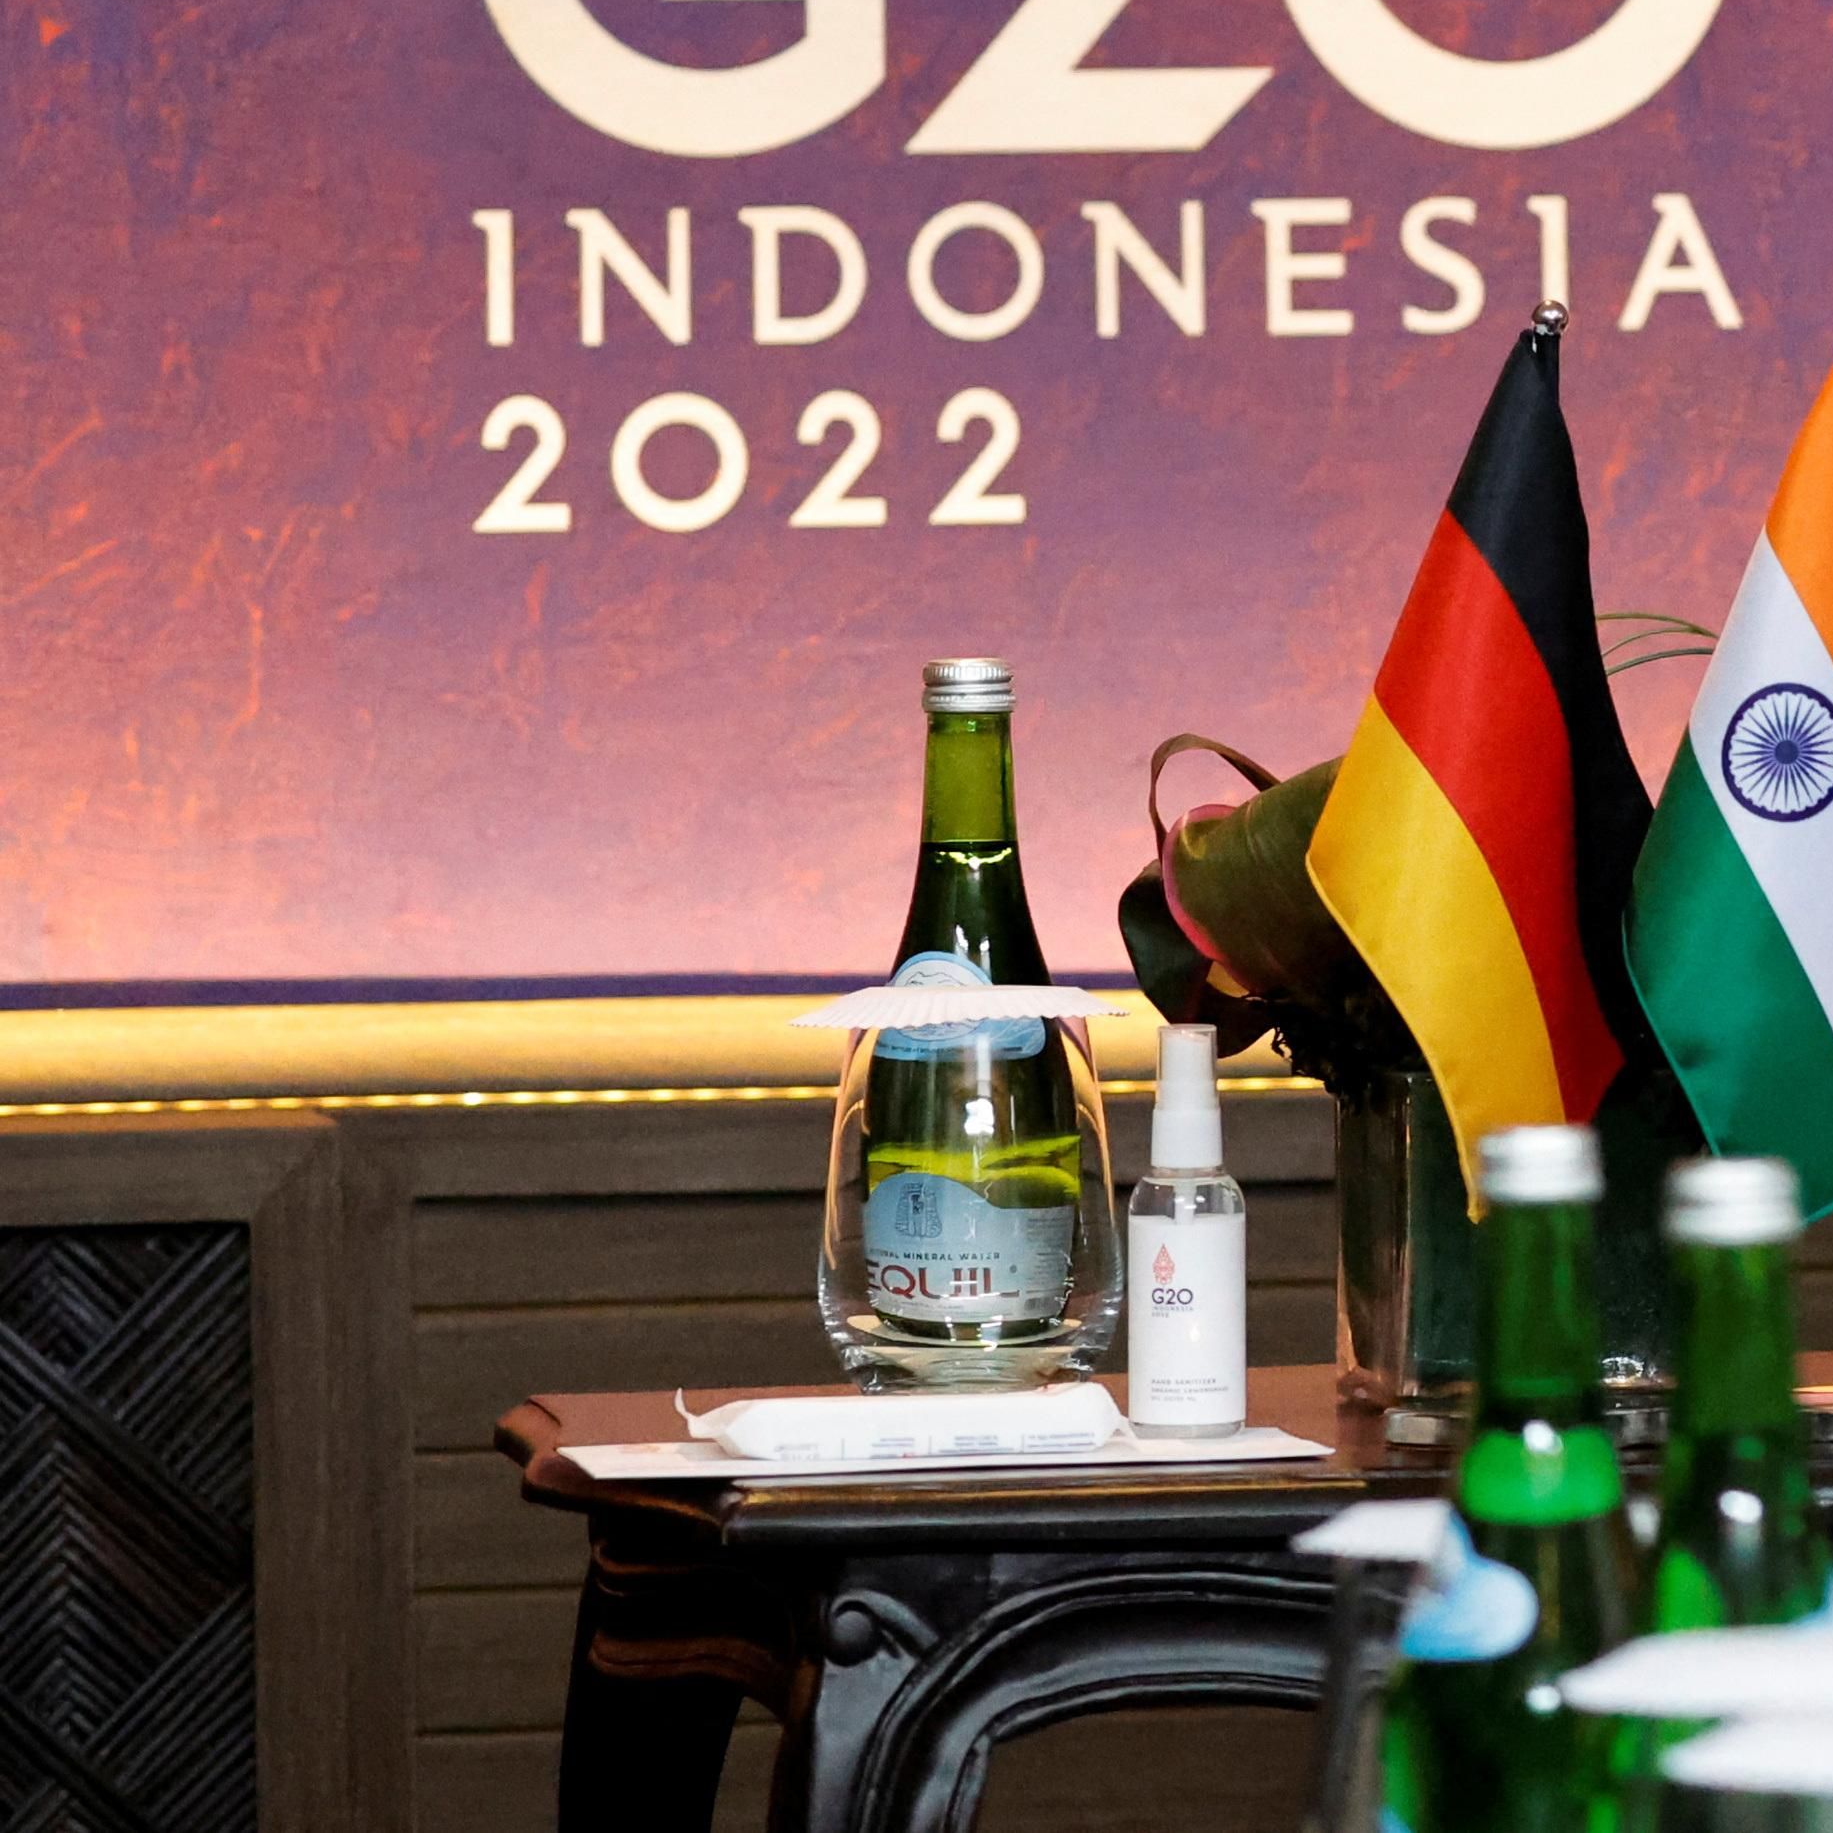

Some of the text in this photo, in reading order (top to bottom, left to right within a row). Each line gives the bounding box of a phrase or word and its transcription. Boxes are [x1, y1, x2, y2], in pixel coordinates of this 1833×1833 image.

[472, 193, 1742, 346] INDONESIA
[473, 387, 1027, 534] 2022
[903, 1252, 953, 1261] MINERAL
[1151, 1288, 1193, 1305] G20
